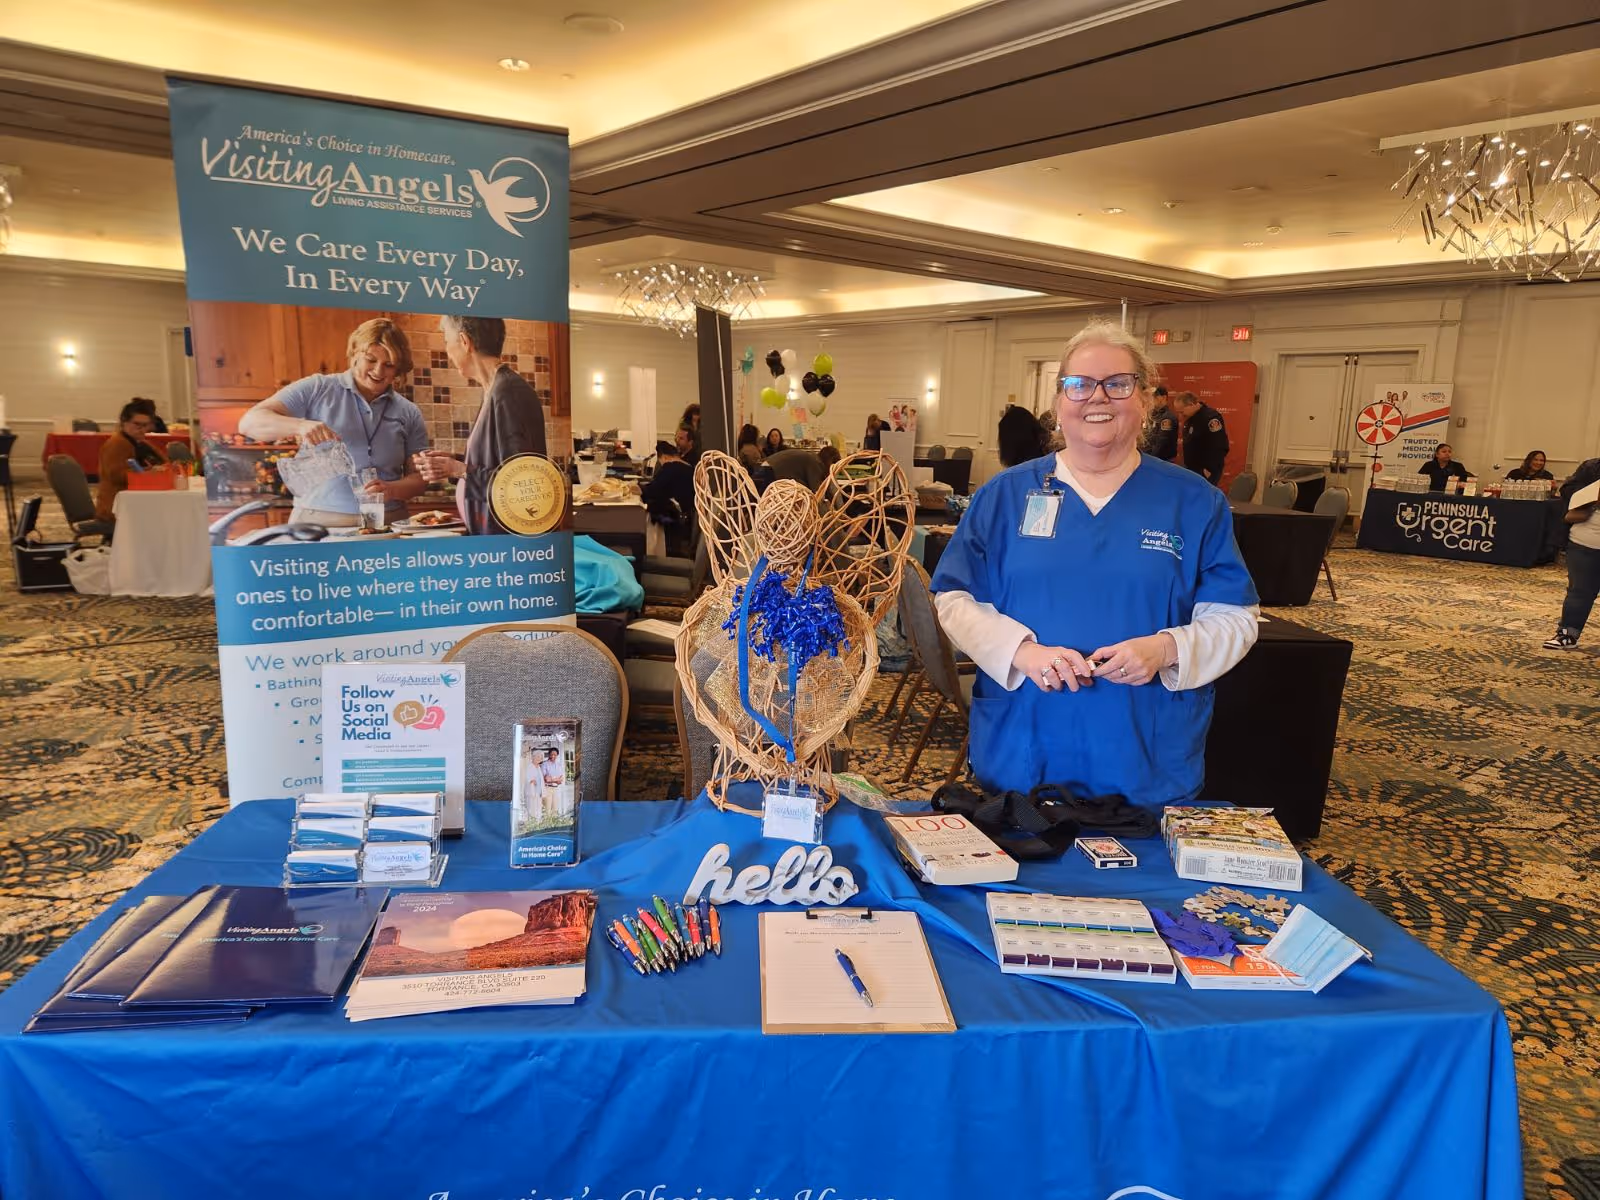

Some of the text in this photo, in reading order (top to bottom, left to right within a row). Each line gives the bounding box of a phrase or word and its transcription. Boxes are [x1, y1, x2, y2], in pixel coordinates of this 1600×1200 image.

[237, 125, 313, 147] America's
[317, 136, 363, 154] Choice
[367, 142, 382, 156] in
[332, 196, 473, 219] LIVING ASSISTANCE SERVICES
[231, 226, 524, 280] We Care Every Day,
[284, 264, 320, 290] In
[328, 268, 412, 304] Every
[1424, 501, 1489, 519] PENINSULA
[1141, 528, 1169, 540] Visiting
[1142, 537, 1173, 548] Angels
[1443, 533, 1493, 552] Care
[250, 544, 554, 577] Visiting Angels allows your loved
[236, 568, 566, 605] ones to live where they are the most
[400, 603, 416, 618] in
[421, 599, 462, 617] their
[467, 600, 504, 613] own
[509, 594, 558, 610] home.
[244, 654, 285, 672] We
[292, 647, 346, 667] work
[353, 639, 424, 661] around
[341, 685, 396, 699] Follow
[341, 700, 385, 713] Us on
[341, 713, 389, 727] Social
[341, 728, 392, 741] Media
[891, 816, 966, 832] 100
[683, 843, 860, 906] hello
[413, 905, 437, 913] 2024
[424, 979, 475, 988] TORRANCE
[502, 975, 529, 983] SUITE
[437, 972, 513, 982] VISITING ANGELS
